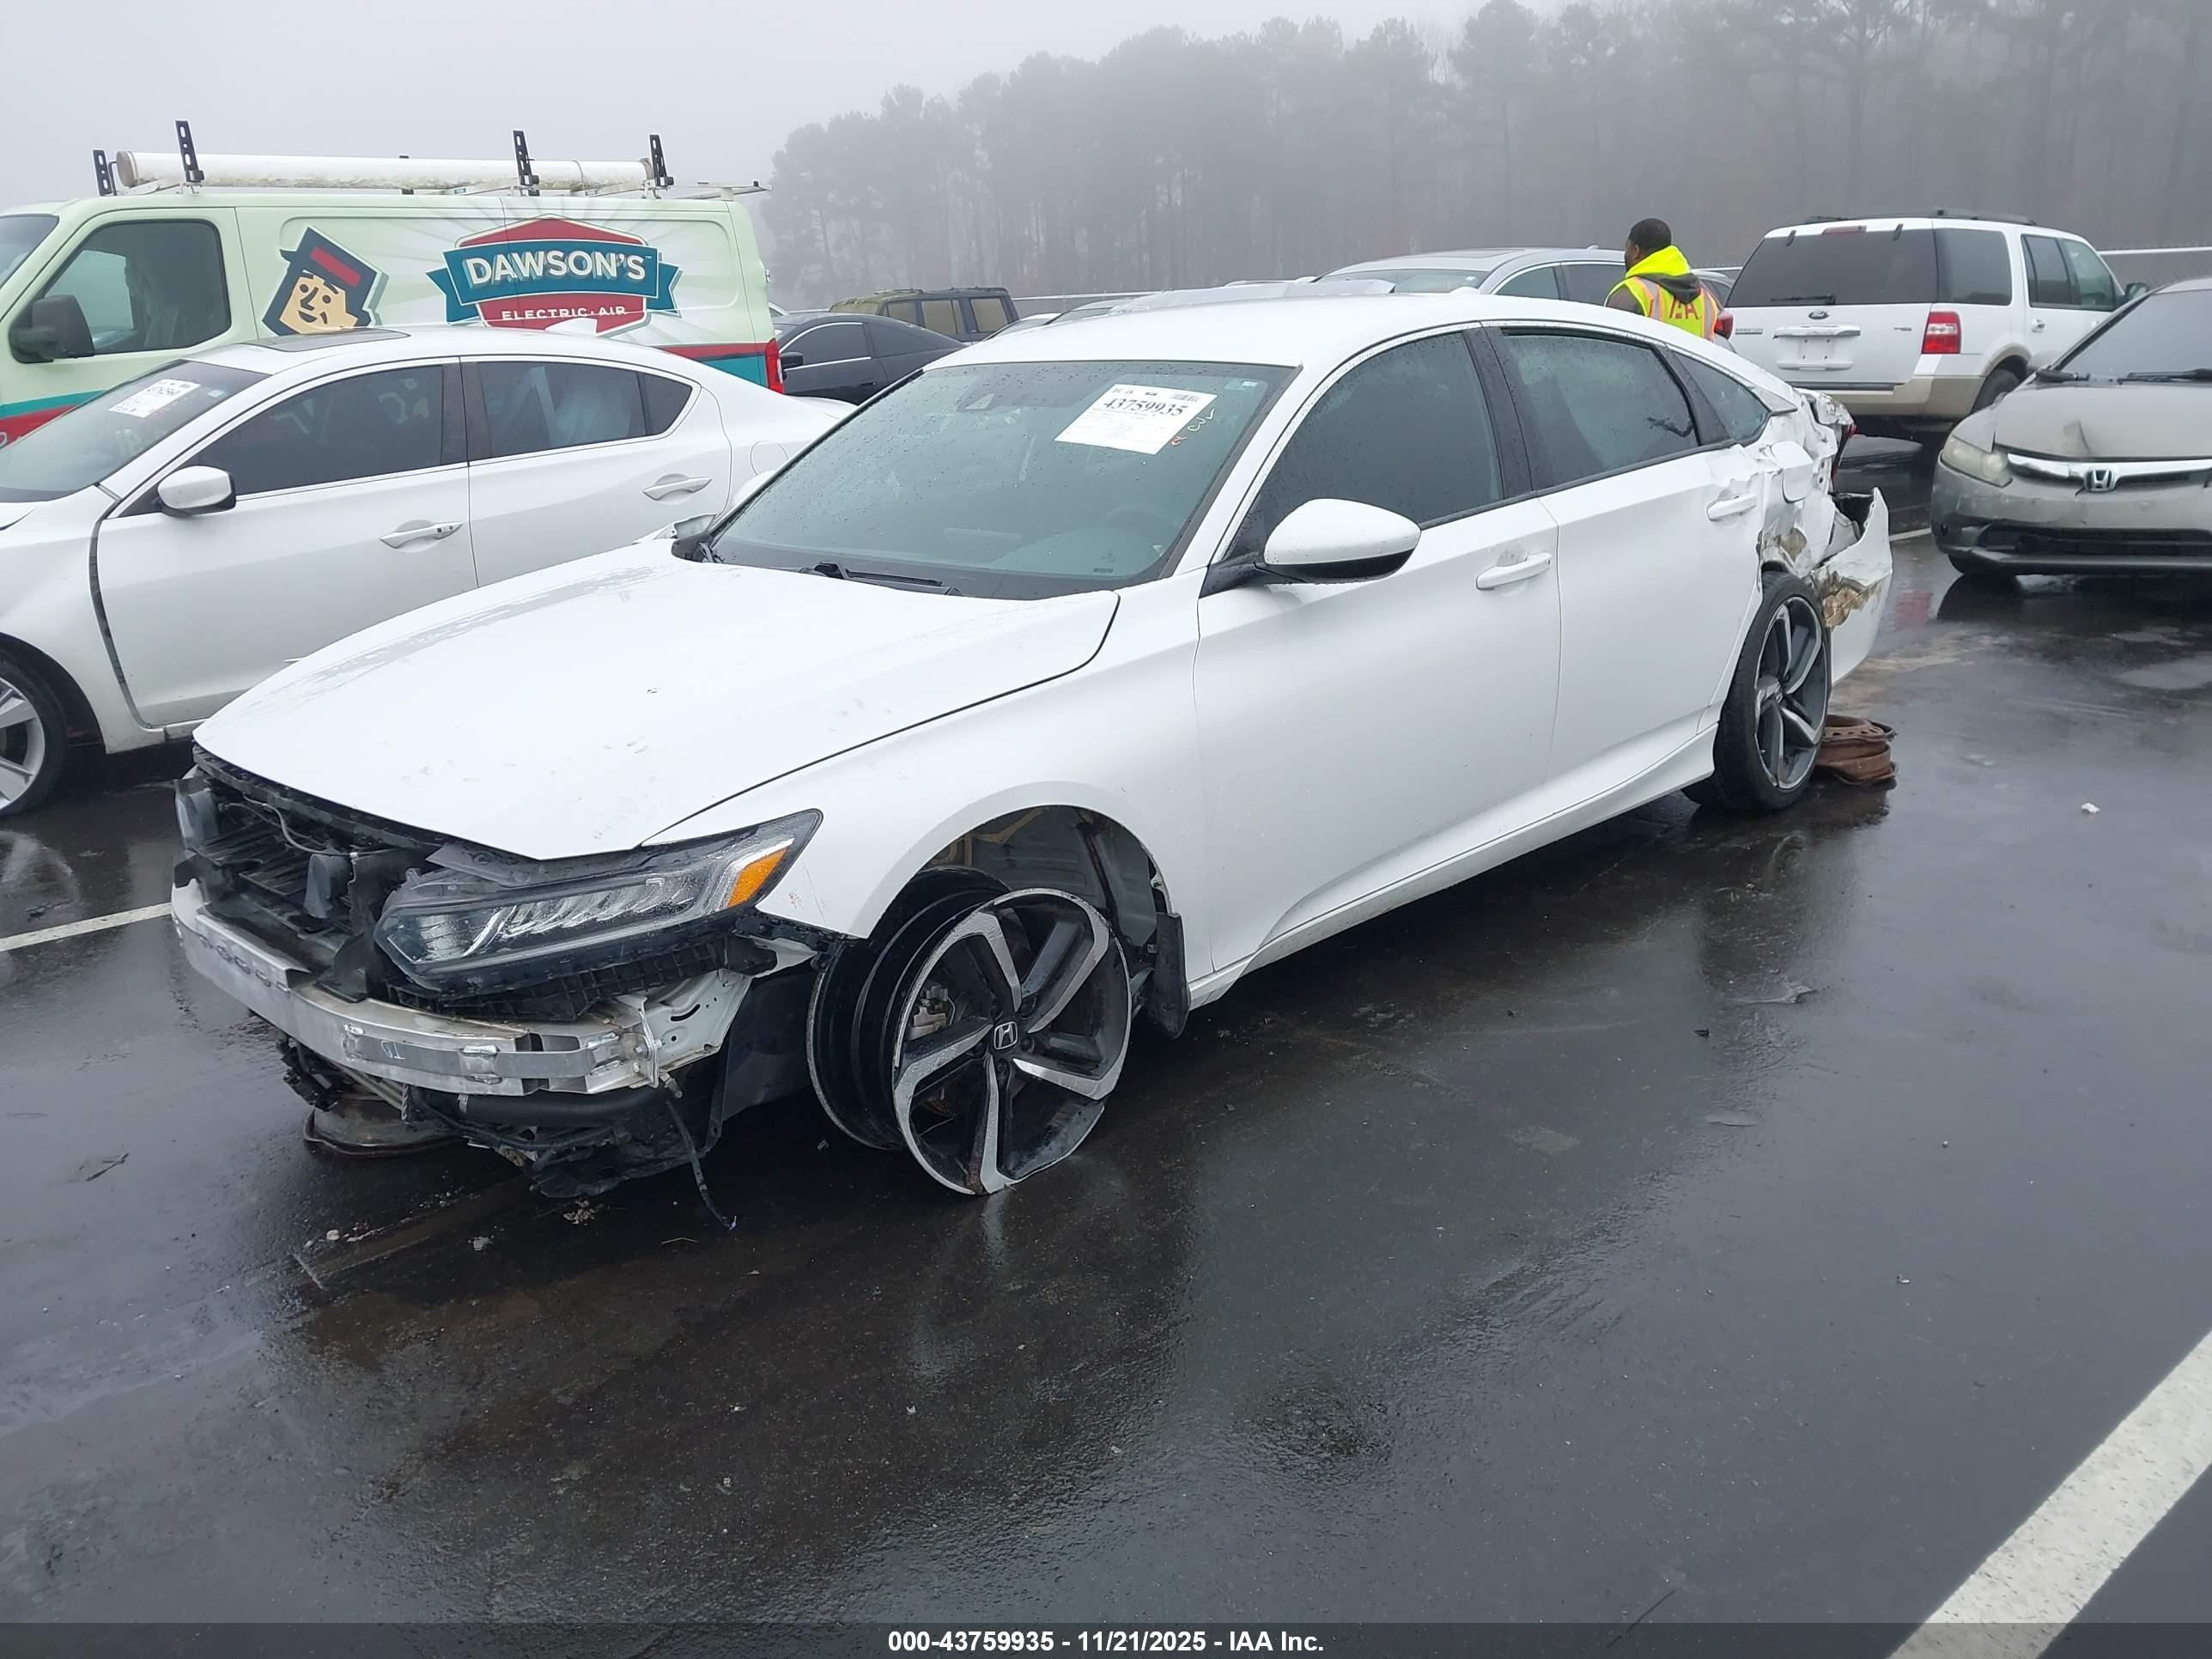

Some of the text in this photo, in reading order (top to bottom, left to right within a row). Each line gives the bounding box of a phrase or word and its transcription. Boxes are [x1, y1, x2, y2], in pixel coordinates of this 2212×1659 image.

[464, 250, 646, 287] DAWSON'S
[501, 306, 627, 320] ELECTRIC AIR
[1103, 398, 1188, 416] 43759935
